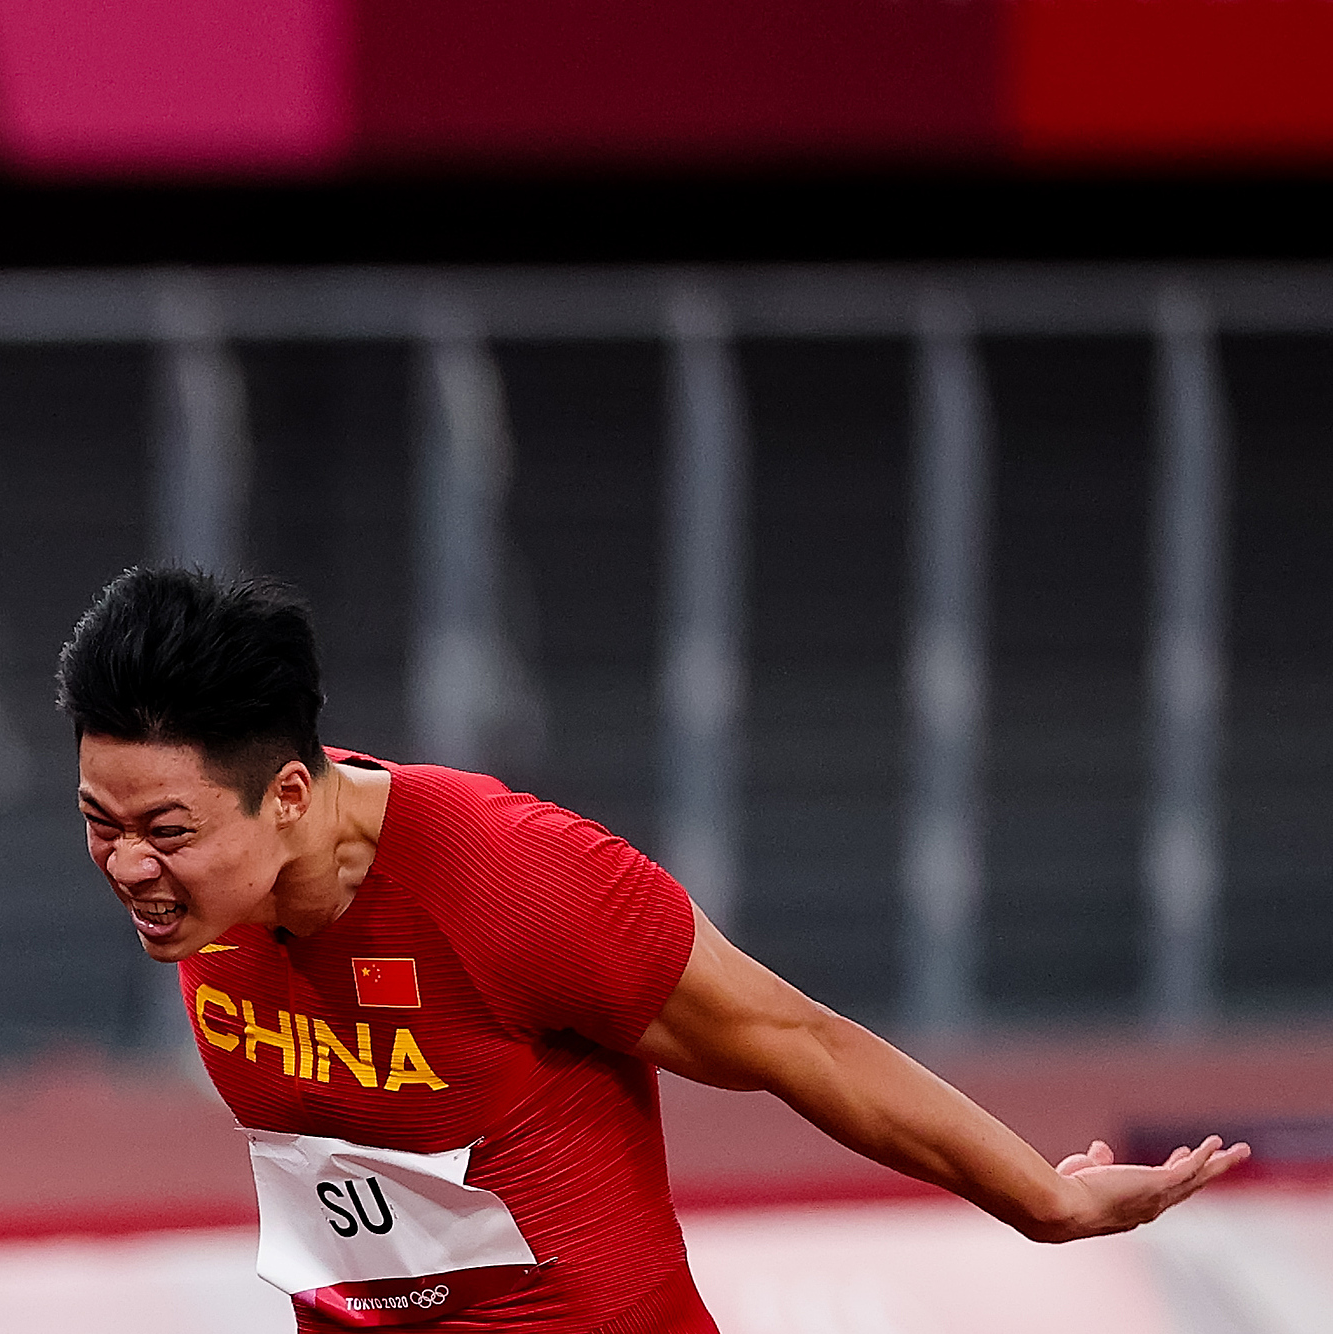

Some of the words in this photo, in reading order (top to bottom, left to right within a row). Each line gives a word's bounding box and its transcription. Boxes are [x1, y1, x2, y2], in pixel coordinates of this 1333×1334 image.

[195, 983, 449, 1092] CHINA
[316, 1176, 394, 1238] SU
[345, 1297, 383, 1311] TOKYO
[382, 1295, 409, 1309] 2020
